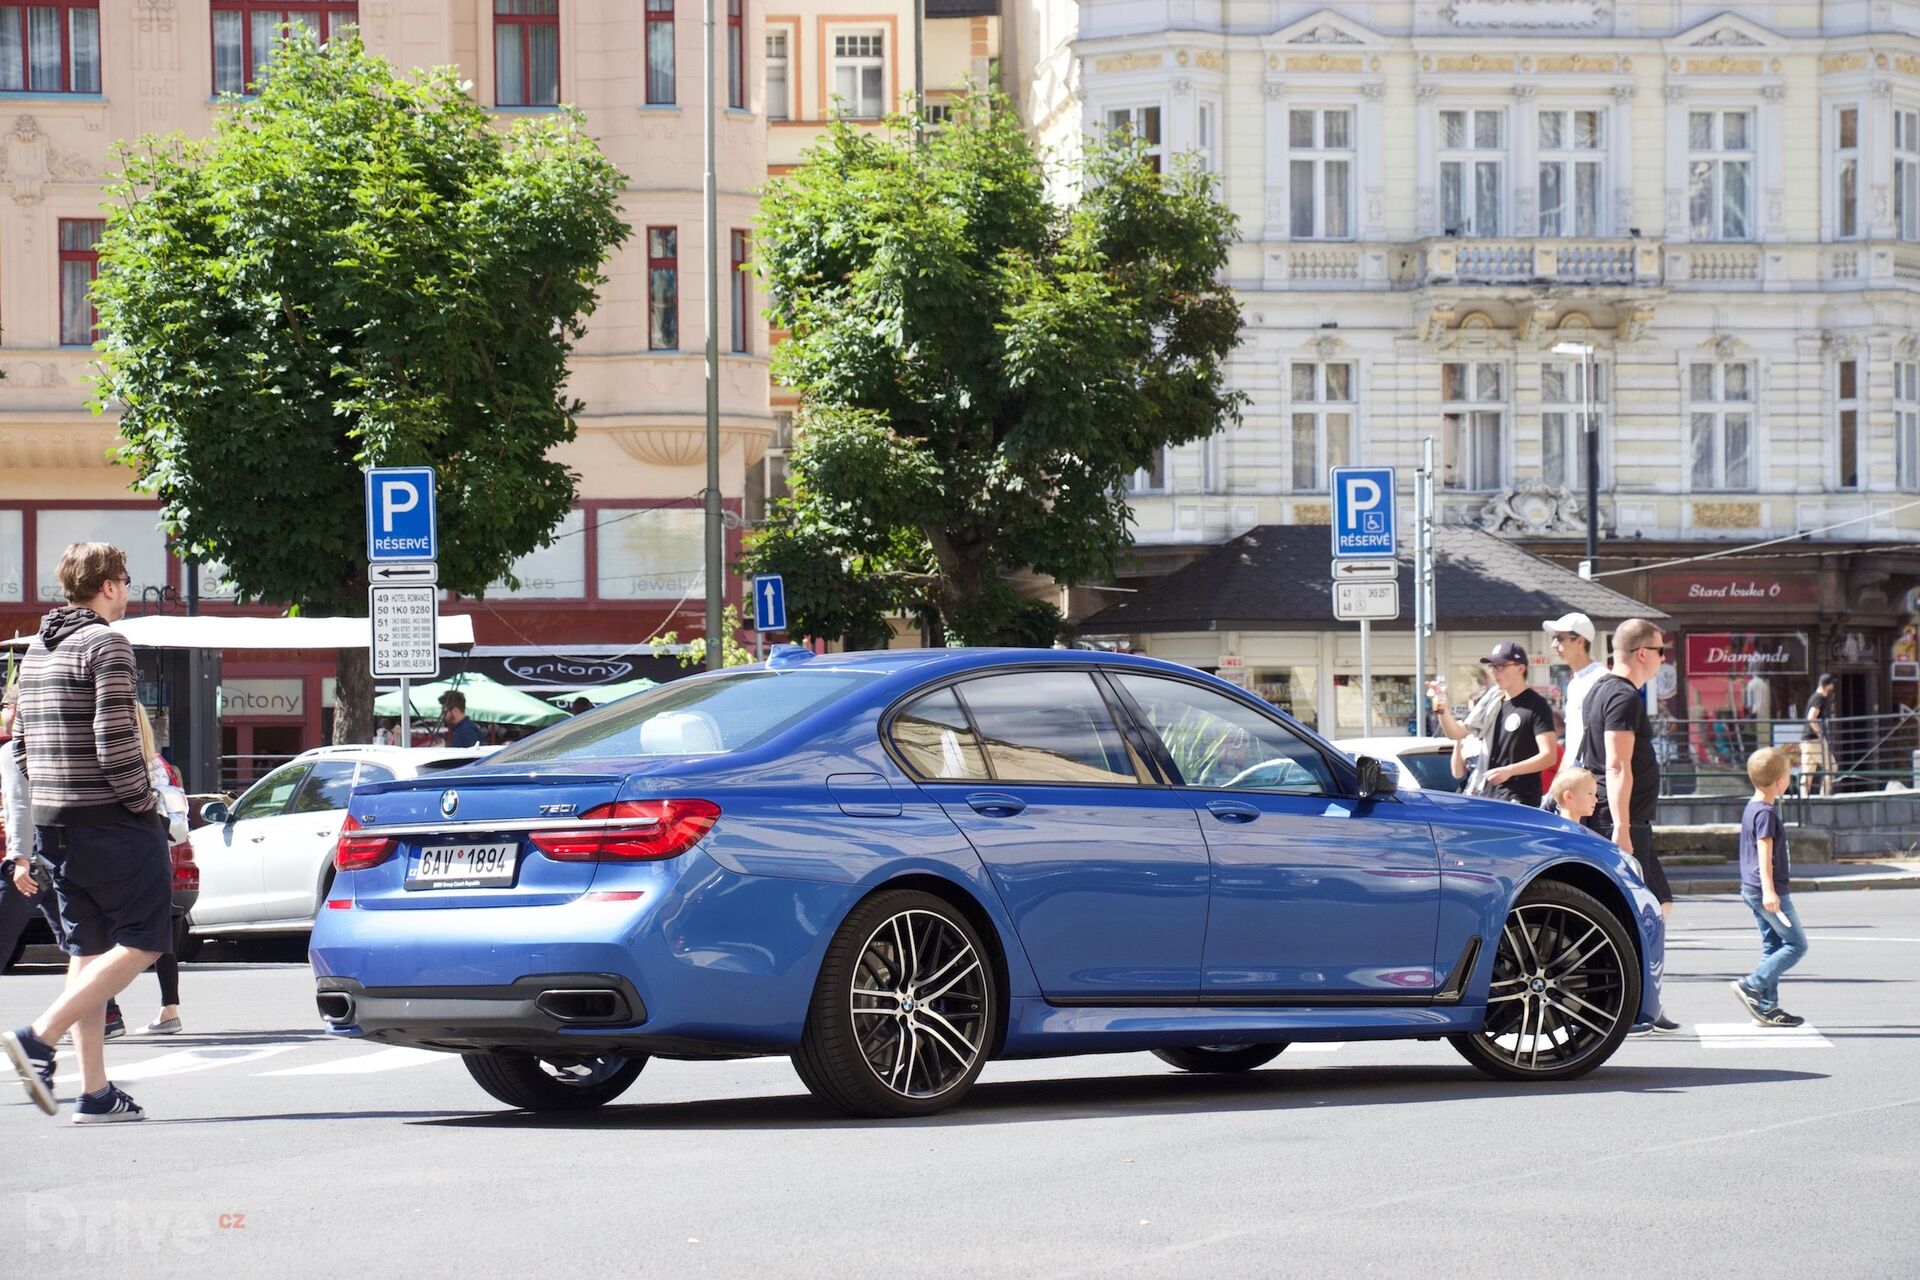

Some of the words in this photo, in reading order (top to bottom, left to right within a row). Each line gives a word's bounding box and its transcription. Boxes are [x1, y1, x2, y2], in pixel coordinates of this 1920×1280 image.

[382, 481, 419, 533] P
[1346, 479, 1382, 529] P
[375, 536, 430, 551] RÉSERVÉ
[1340, 532, 1391, 547] RÉSERVÉ
[1688, 583, 1726, 597] Stará
[1730, 582, 1765, 597] louka
[377, 594, 389, 603] 49
[377, 606, 389, 614] 50
[377, 618, 388, 627] 51
[377, 634, 389, 642] 52
[378, 650, 390, 658] 53
[1707, 645, 1790, 664] Diamonds
[378, 660, 390, 668] 54
[517, 662, 625, 678] antony
[422, 849, 454, 876] 6AV
[467, 847, 506, 874] 1894
